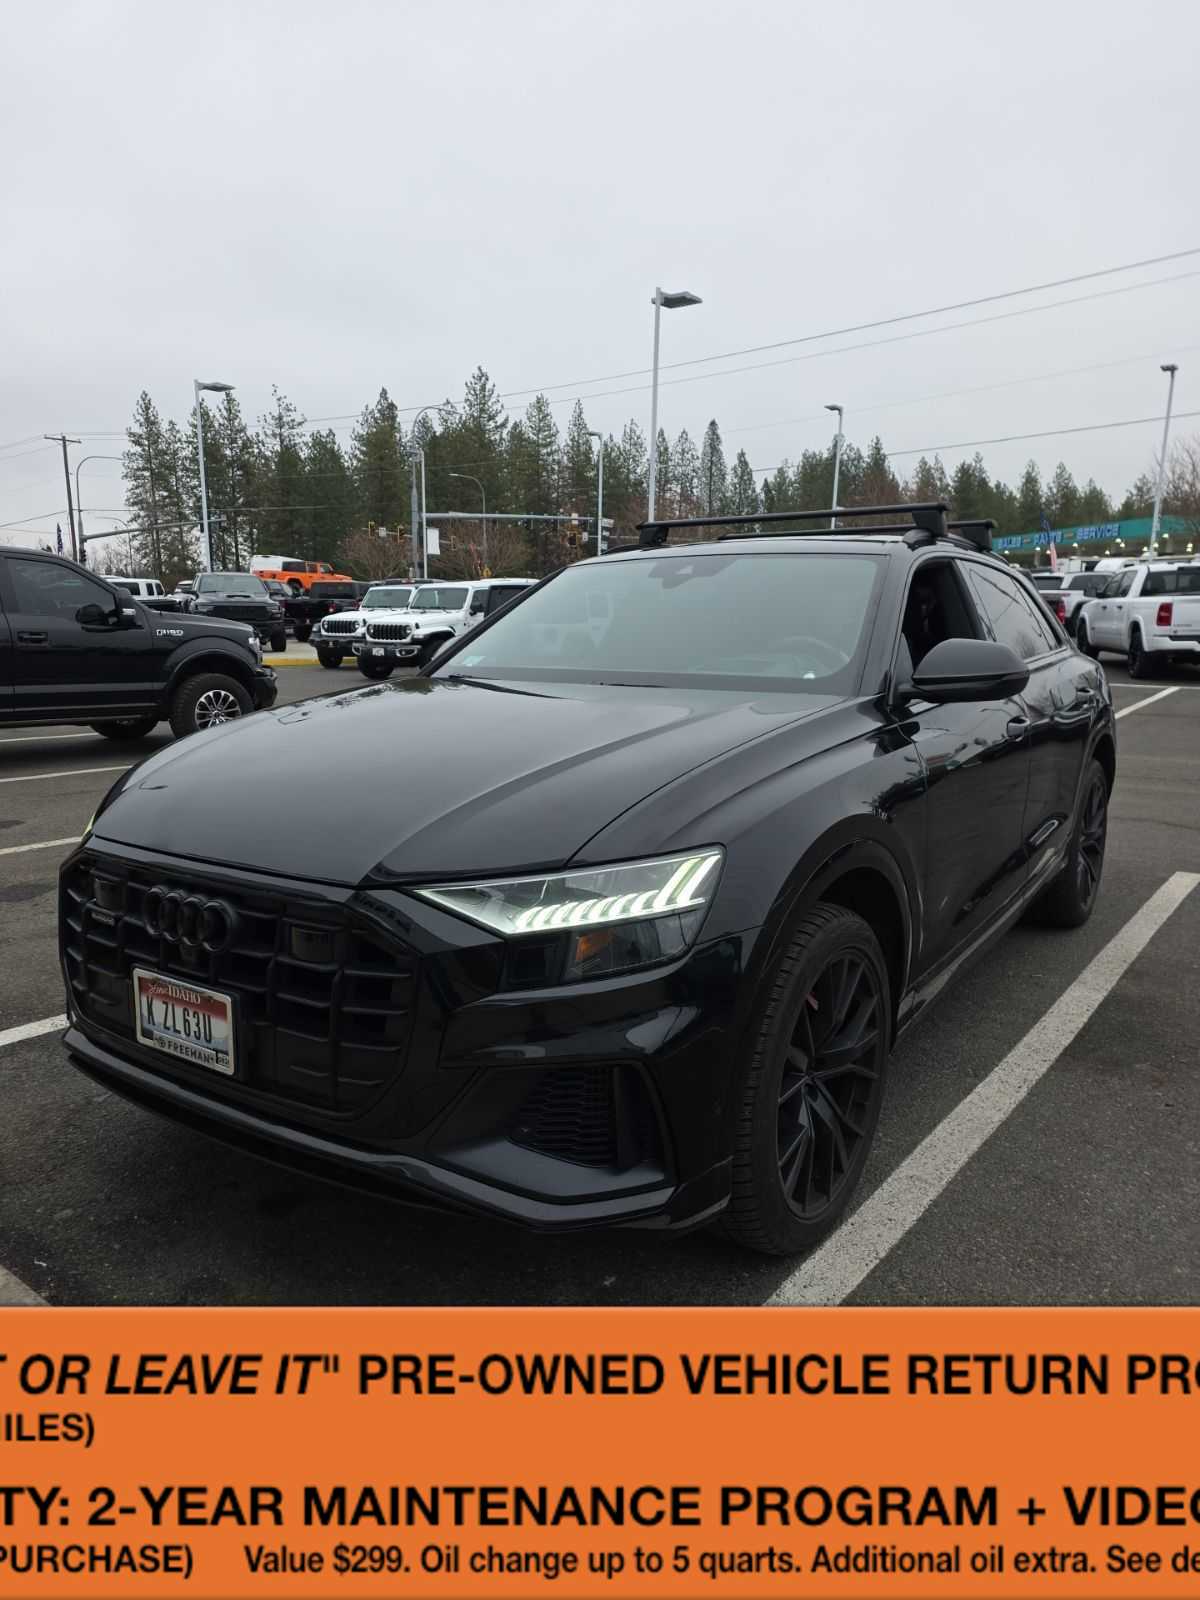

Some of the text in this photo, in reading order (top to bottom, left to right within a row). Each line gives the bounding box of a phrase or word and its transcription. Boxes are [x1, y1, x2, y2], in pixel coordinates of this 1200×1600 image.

[1076, 523, 1120, 540] SERVICE
[167, 984, 201, 1005] IDAHO
[167, 1040, 210, 1064] FREEMAN
